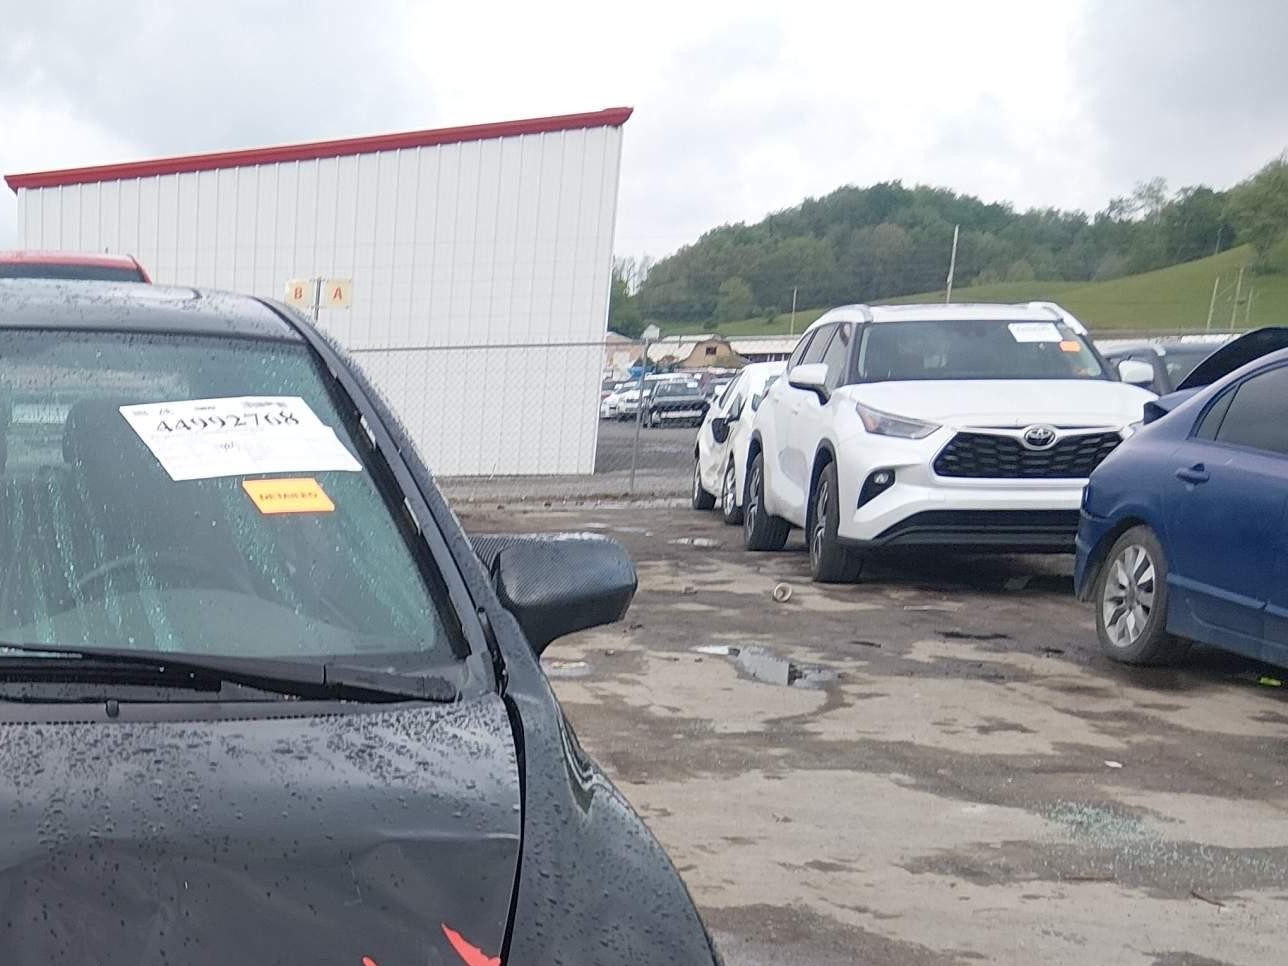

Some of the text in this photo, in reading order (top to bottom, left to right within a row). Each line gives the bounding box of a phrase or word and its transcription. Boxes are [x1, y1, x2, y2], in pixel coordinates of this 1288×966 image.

[294, 287, 303, 300] B
[333, 287, 343, 300] A
[156, 410, 300, 433] 44992768
